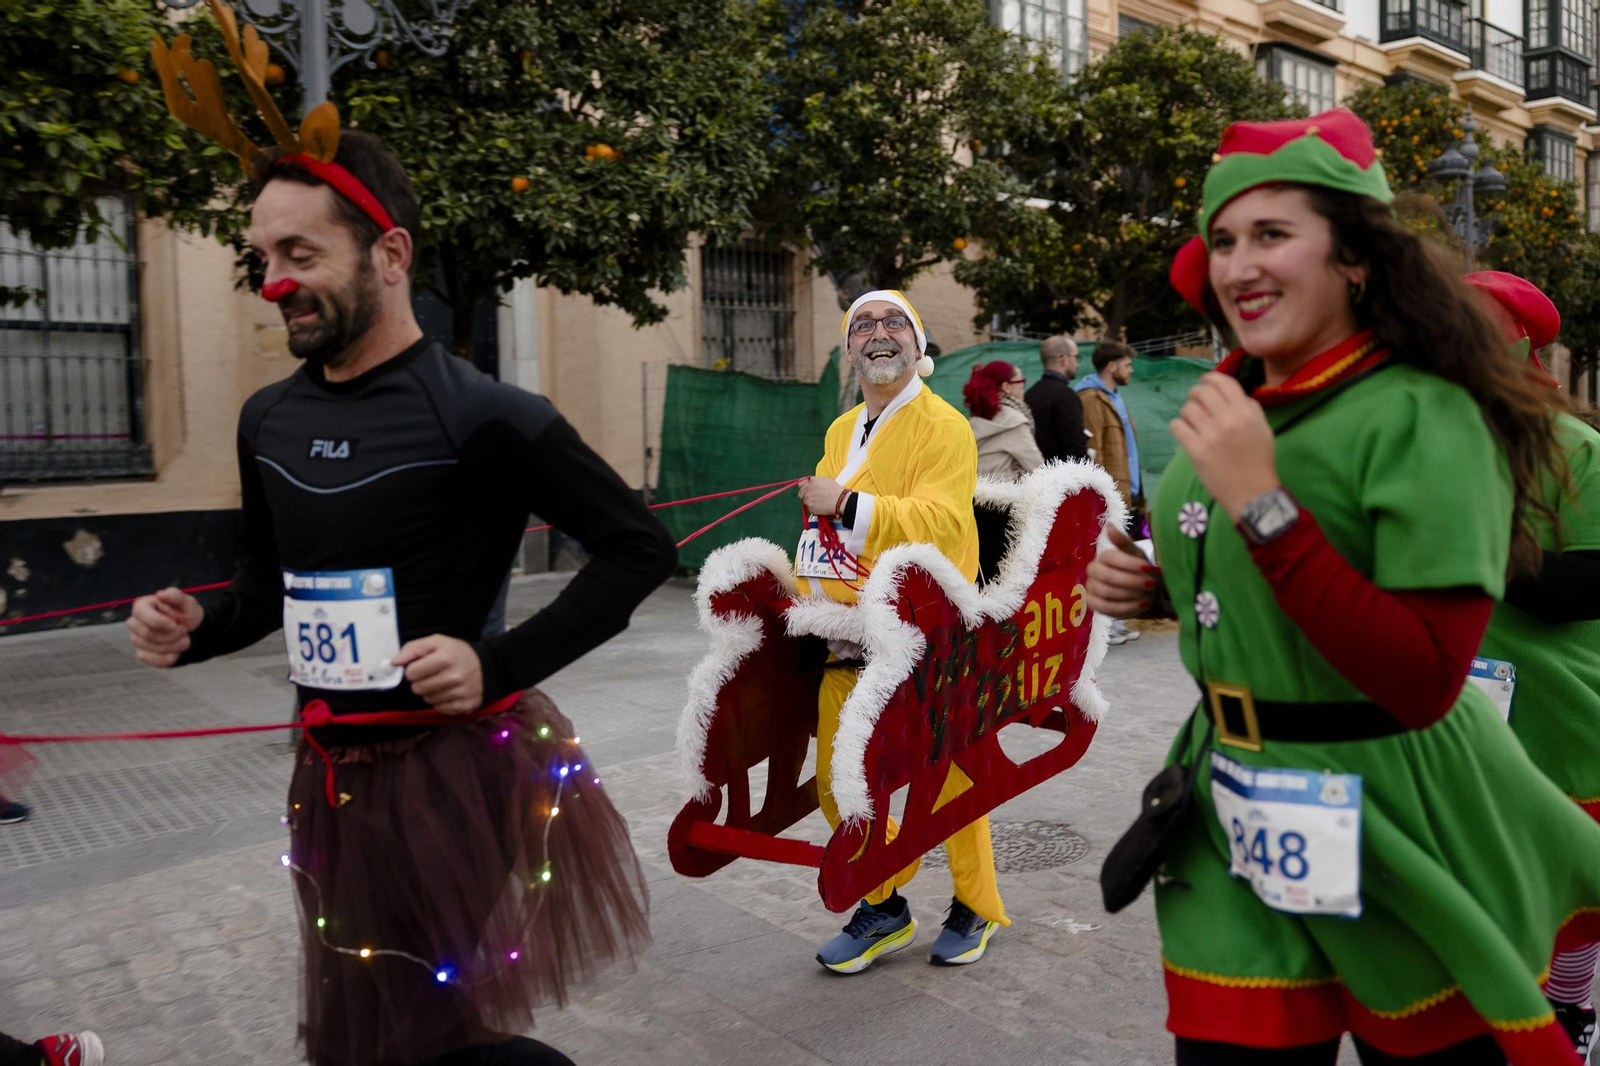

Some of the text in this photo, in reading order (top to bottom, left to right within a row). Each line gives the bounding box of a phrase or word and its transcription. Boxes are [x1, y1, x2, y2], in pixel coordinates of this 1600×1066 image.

[309, 439, 350, 459] FILA
[800, 539, 847, 565] 1124
[298, 622, 359, 664] 581
[1232, 816, 1310, 881] 848
